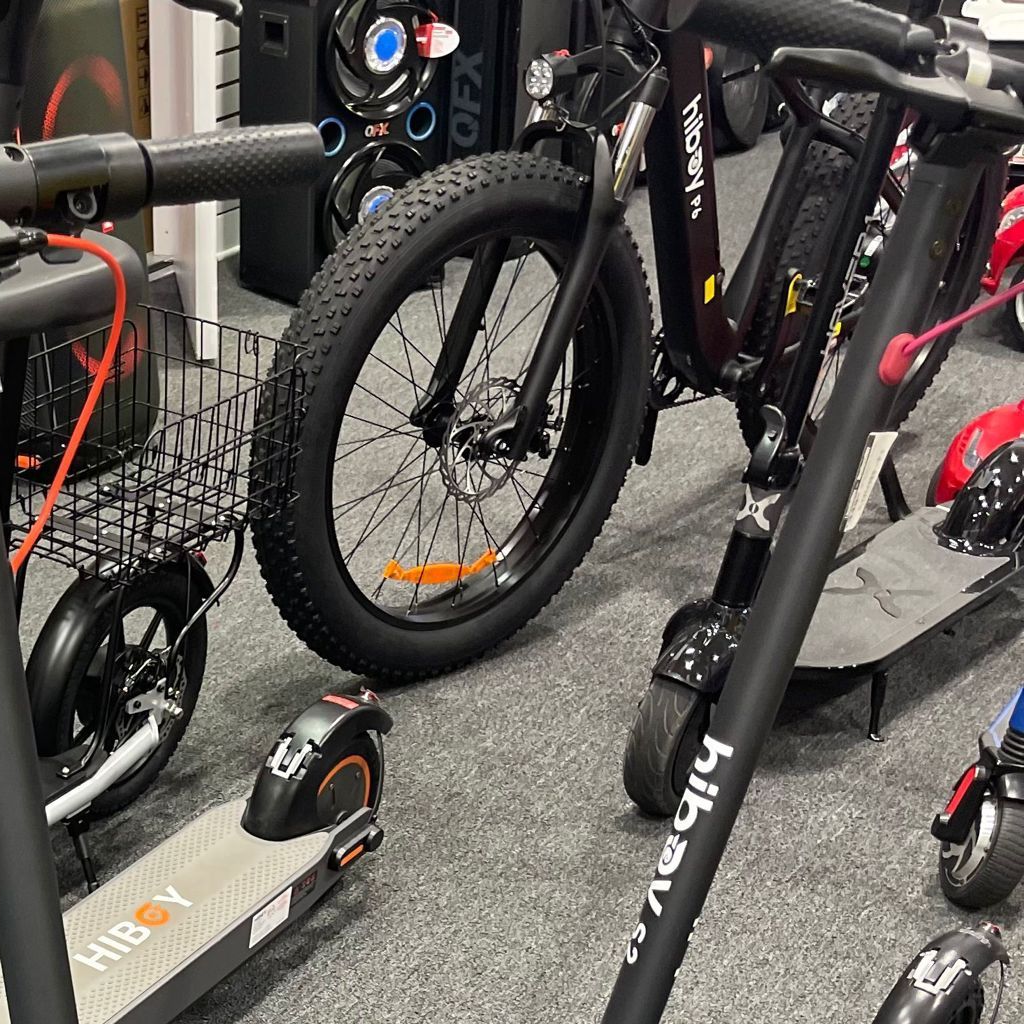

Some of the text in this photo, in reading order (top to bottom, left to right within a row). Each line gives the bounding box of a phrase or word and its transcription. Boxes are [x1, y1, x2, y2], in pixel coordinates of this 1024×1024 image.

[364, 121, 390, 138] QFX
[451, 51, 484, 149] QFX
[682, 92, 705, 193] hiboy
[72, 884, 194, 972] HIBOY
